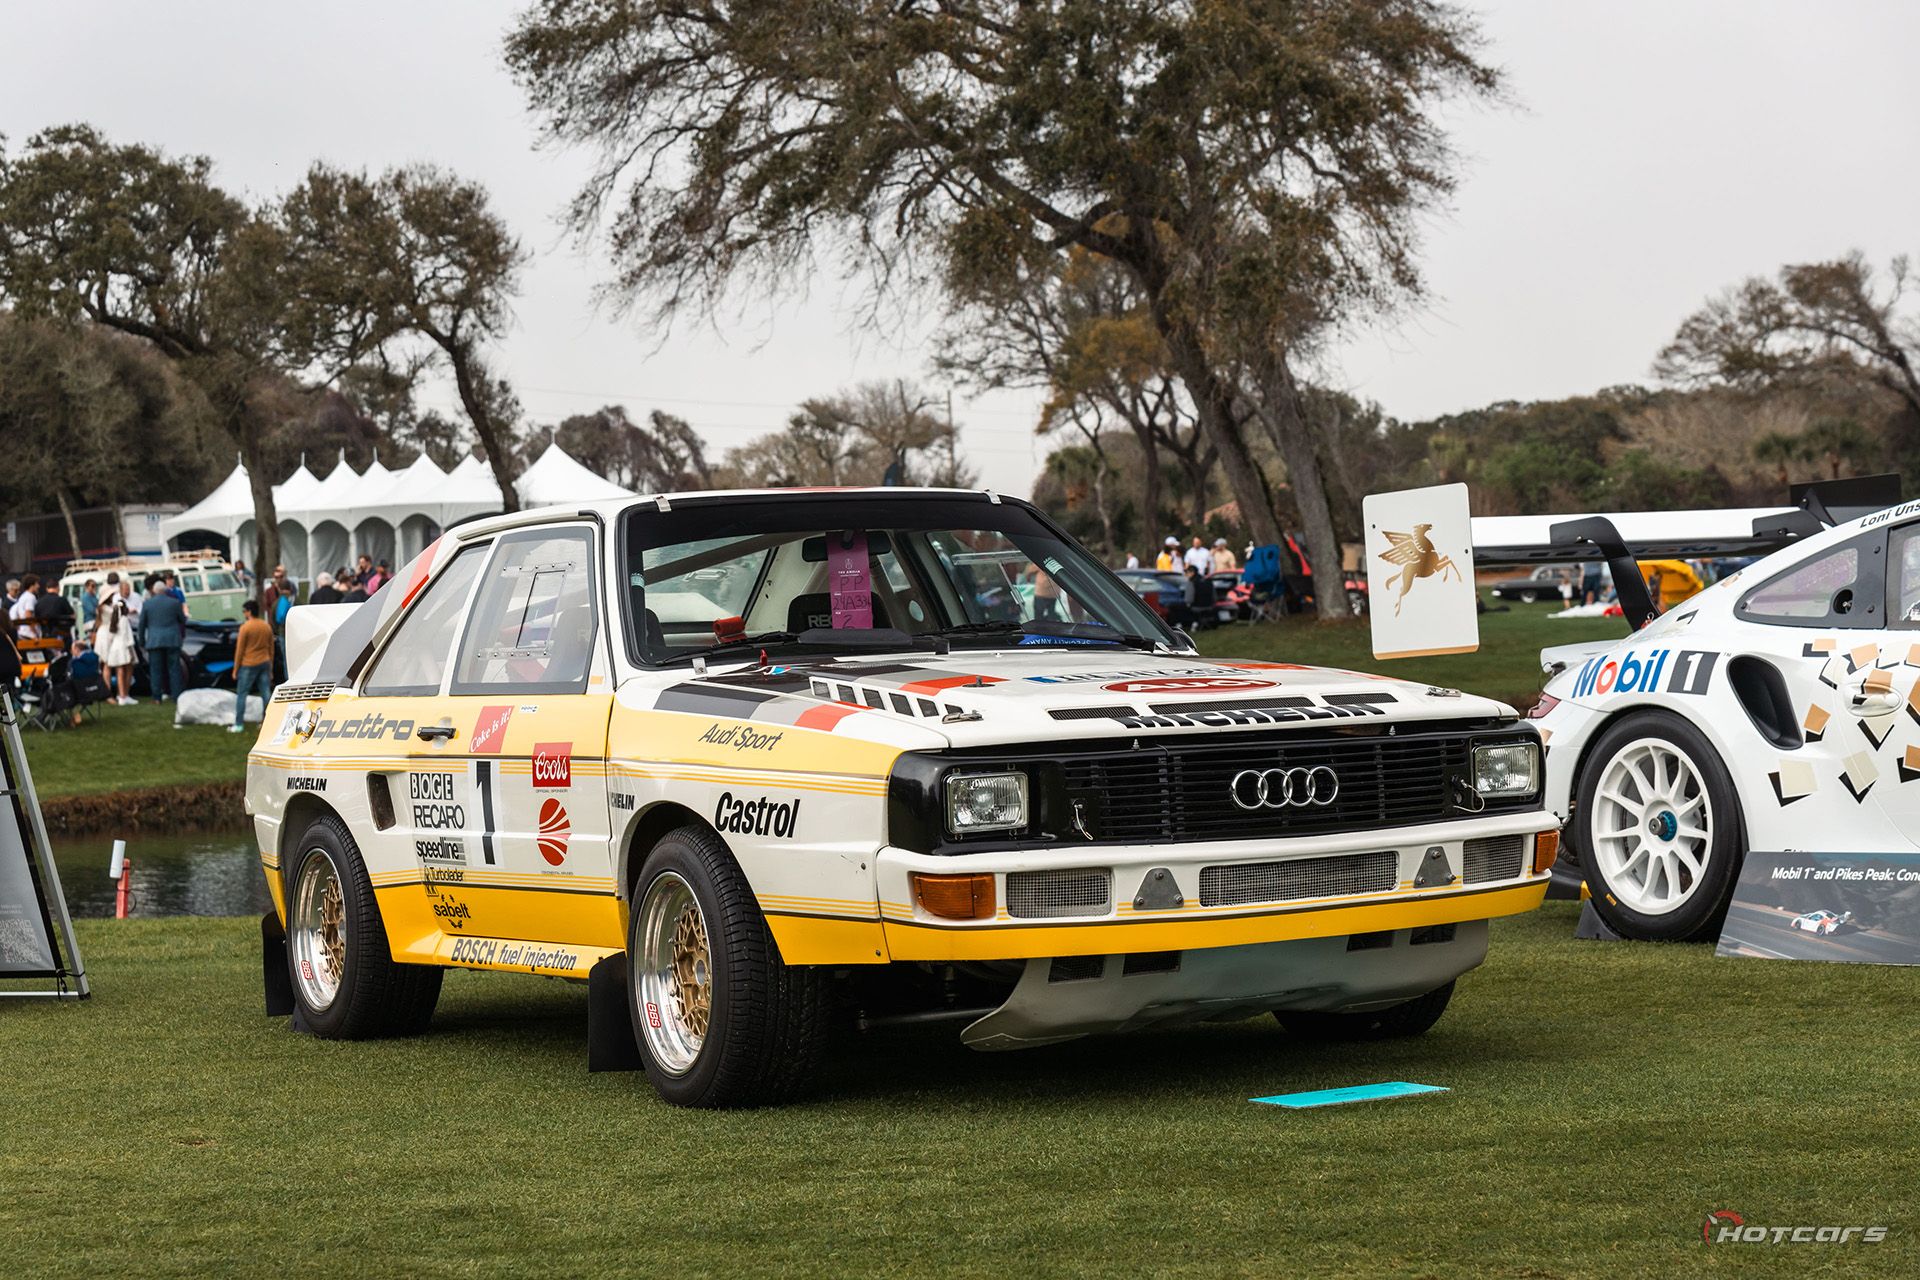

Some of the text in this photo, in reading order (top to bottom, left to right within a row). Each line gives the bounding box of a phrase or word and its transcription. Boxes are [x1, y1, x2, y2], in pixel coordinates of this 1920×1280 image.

[1860, 510, 1892, 528] Loni
[1571, 650, 1670, 698] Mobil
[1682, 653, 1704, 691] 1
[312, 713, 414, 745] quattro
[1110, 703, 1385, 729] MICHELIN
[470, 708, 511, 752] Coke is it!
[698, 723, 783, 751] Audi Sport
[535, 751, 568, 780] Coors
[287, 777, 327, 791] MICHELIN
[410, 773, 454, 800] BOGE
[413, 804, 465, 829] RECARO
[476, 761, 496, 865] 1
[714, 791, 800, 838] Castrol
[416, 837, 460, 863] speedline
[1771, 867, 1802, 879] Mobil
[1813, 867, 1833, 880] and
[1835, 868, 1863, 881] Pikes
[1865, 868, 1895, 881] Peak:
[433, 902, 471, 919] sabelt
[451, 938, 578, 972] BOSCH fuel injection
[302, 961, 312, 979] BBS
[647, 1003, 661, 1027] BBS
